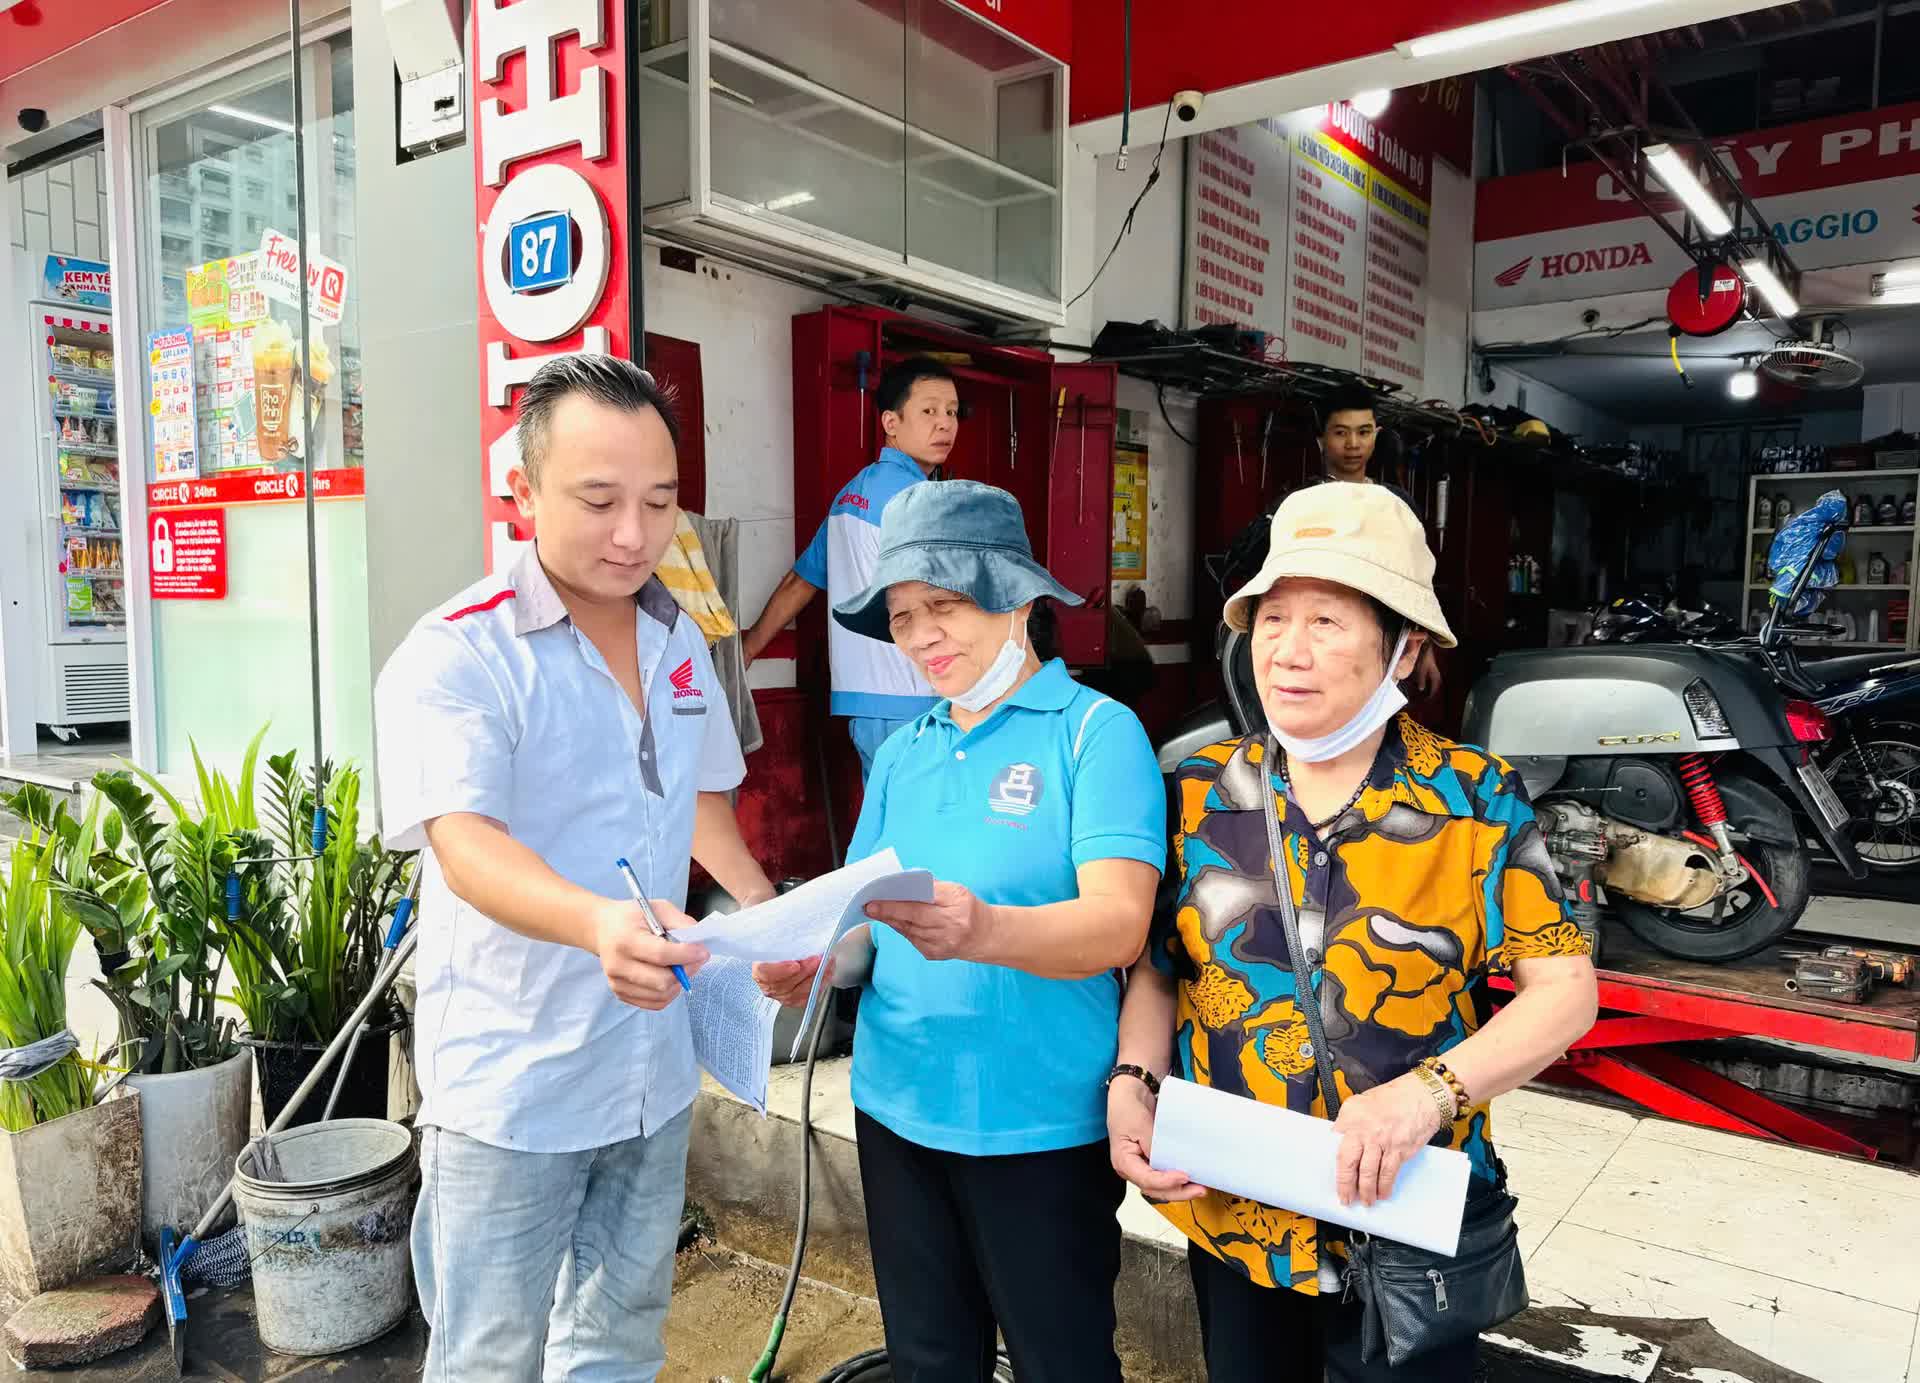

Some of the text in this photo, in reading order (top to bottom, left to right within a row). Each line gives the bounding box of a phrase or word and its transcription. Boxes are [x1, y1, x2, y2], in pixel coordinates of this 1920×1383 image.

[1378, 131, 1408, 175] TOÀN
[1739, 208, 1879, 246] AGGIO
[520, 225, 557, 278] 87
[1541, 242, 1653, 278] HONDA
[65, 271, 92, 283] KEM
[152, 487, 178, 501] CIRCLE
[254, 480, 284, 494] CIRCLE
[673, 688, 704, 699] HONDA
